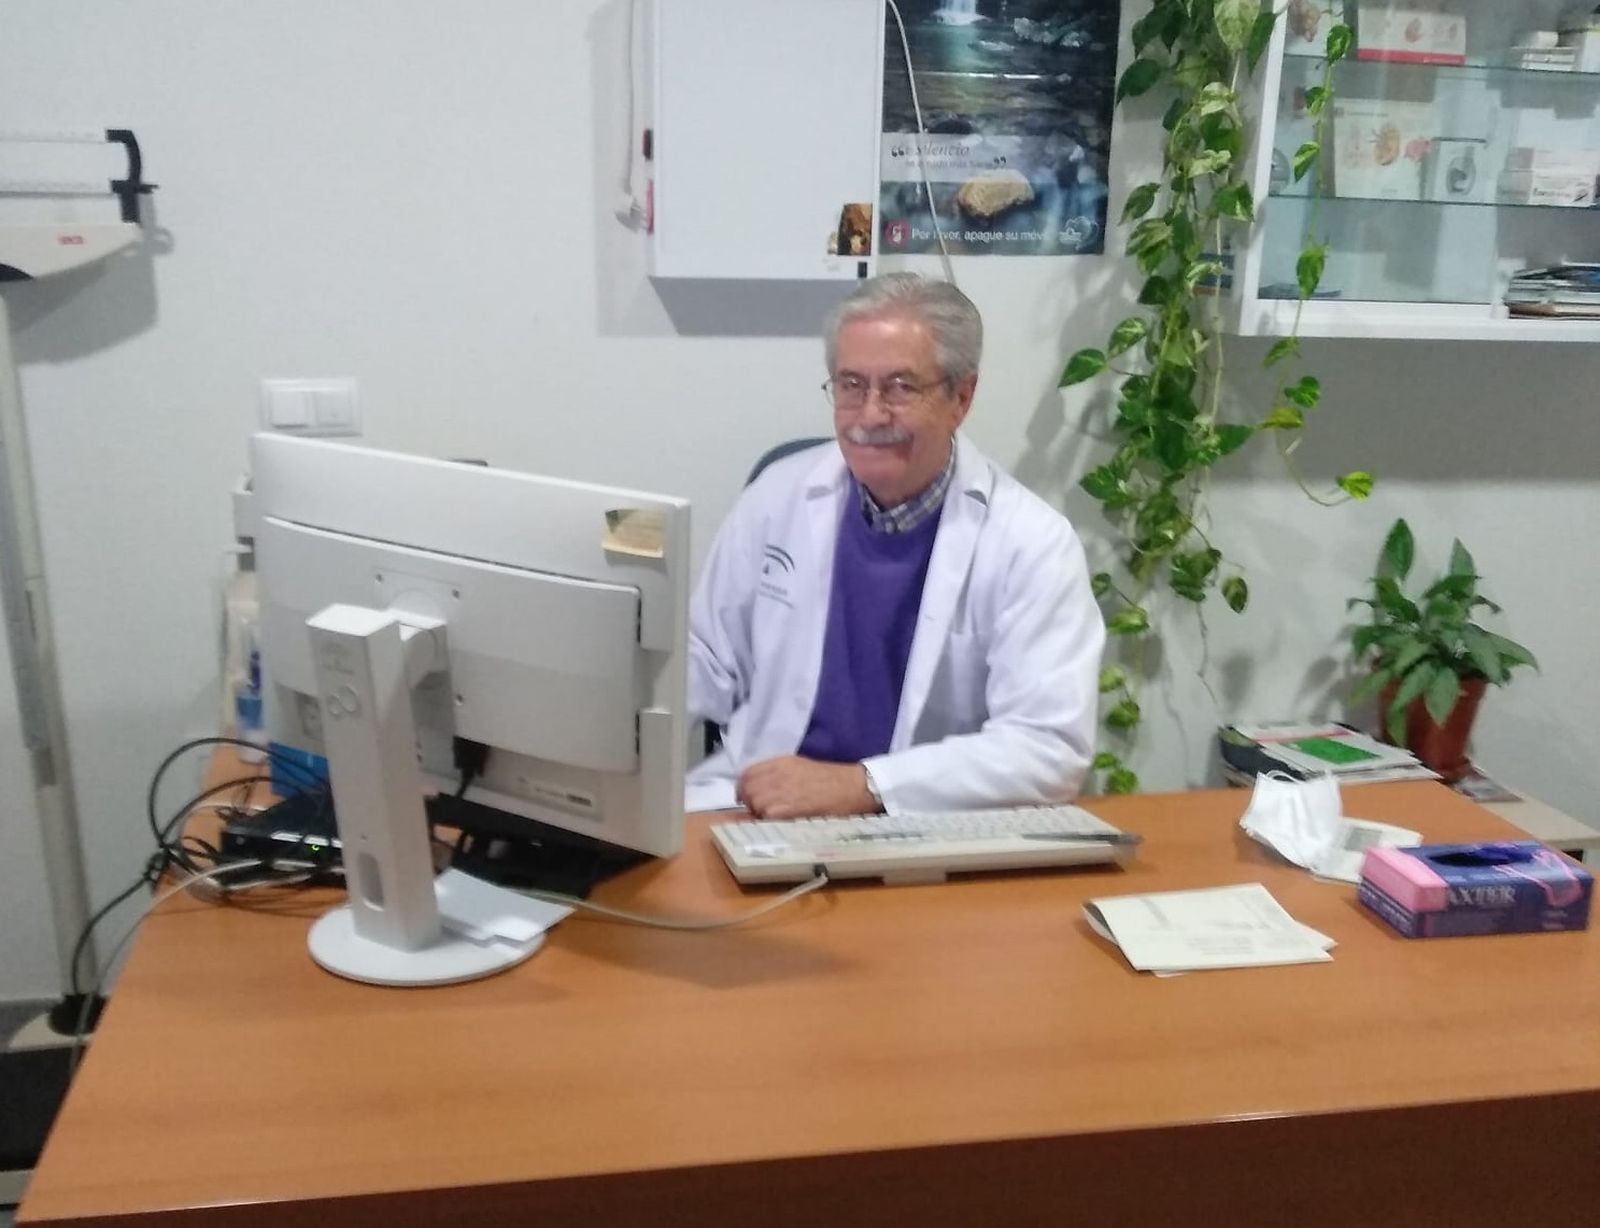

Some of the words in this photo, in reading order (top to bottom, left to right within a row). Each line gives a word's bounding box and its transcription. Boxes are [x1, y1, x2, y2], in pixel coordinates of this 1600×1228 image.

[911, 228, 930, 240] Por
[964, 230, 1003, 243] apague
[1005, 230, 1018, 241] su
